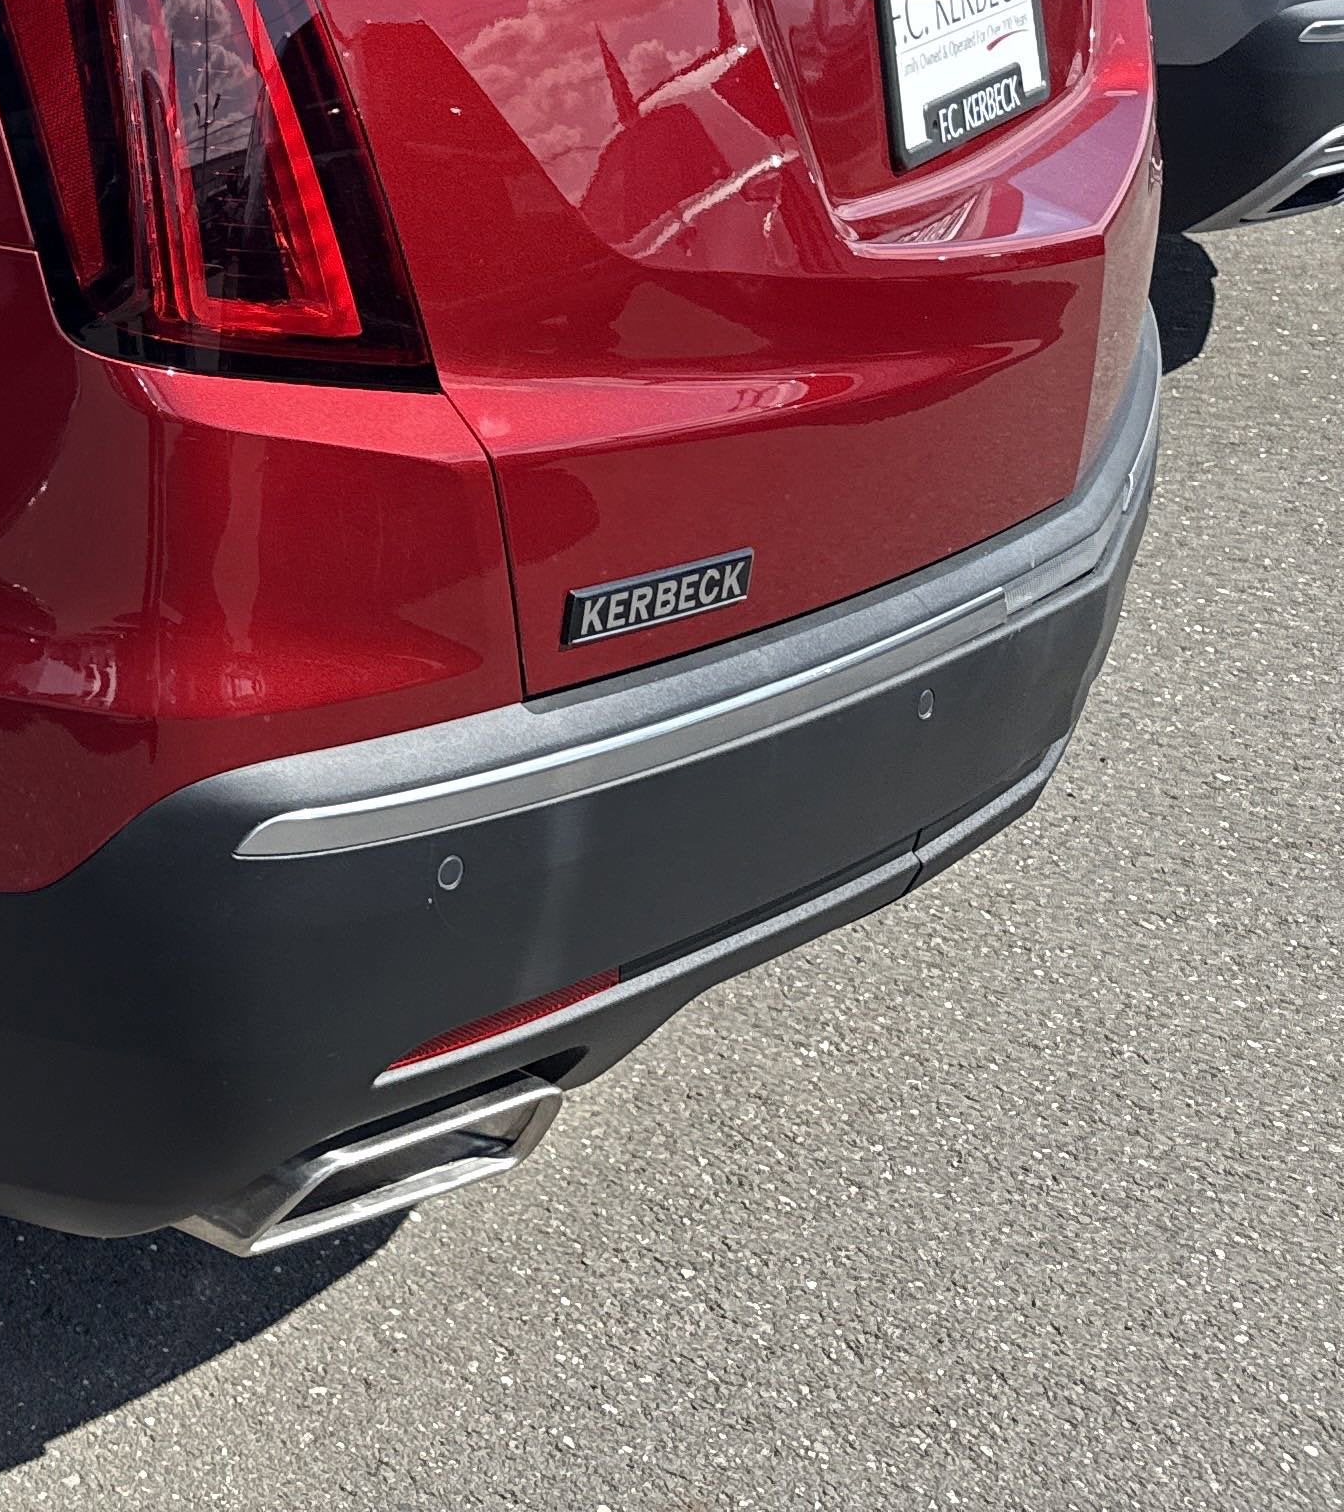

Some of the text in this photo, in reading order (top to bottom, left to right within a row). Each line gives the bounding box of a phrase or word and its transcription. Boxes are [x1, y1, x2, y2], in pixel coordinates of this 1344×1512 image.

[938, 74, 1021, 144] F.C. KERBECK
[580, 561, 746, 636] KERBECK
